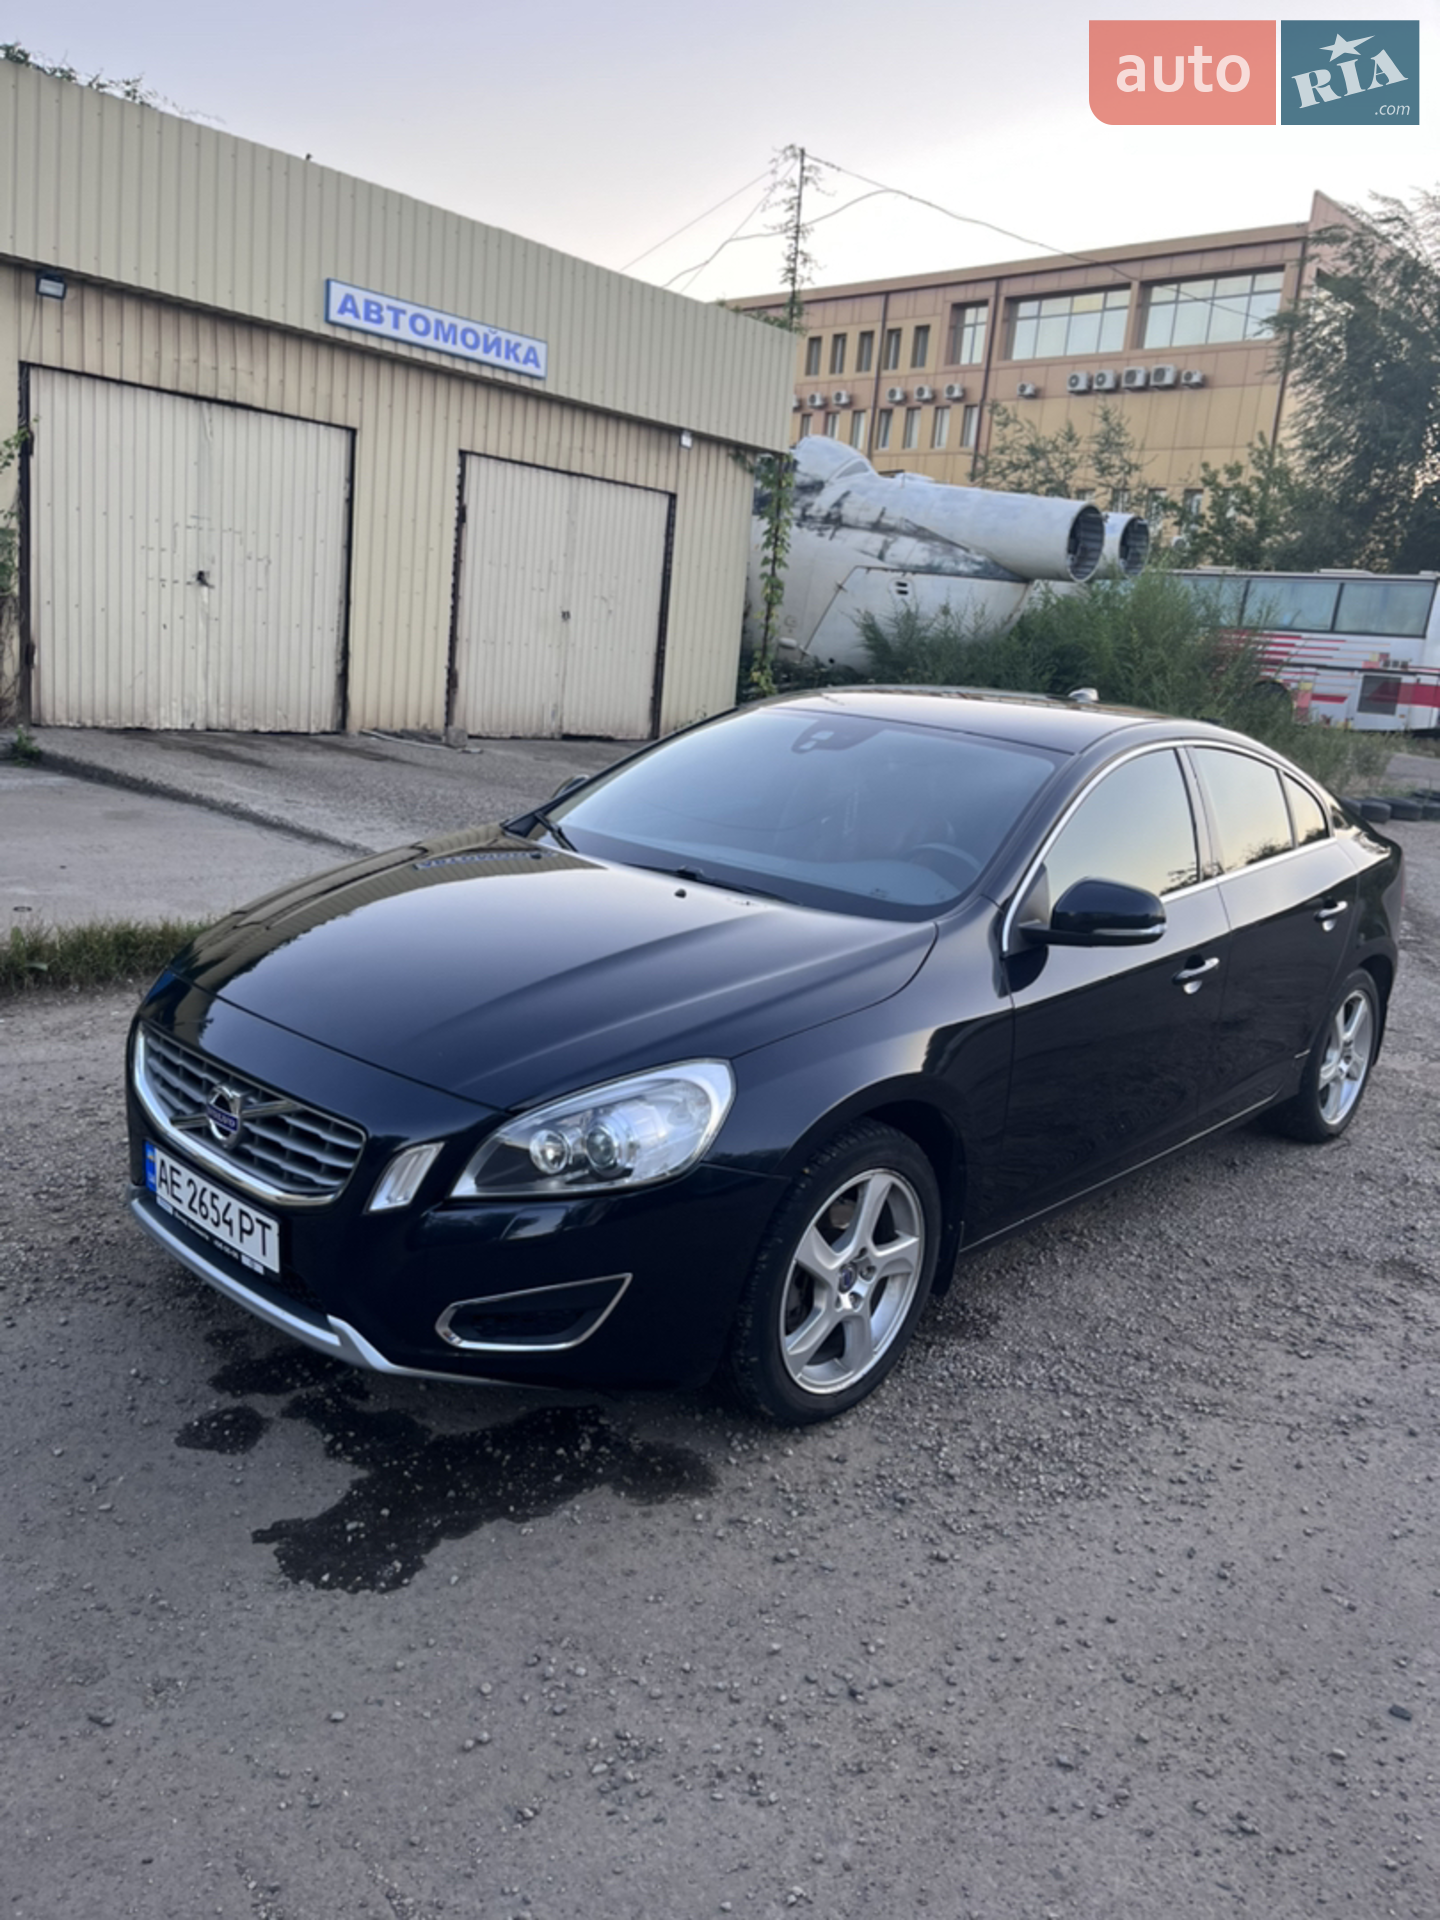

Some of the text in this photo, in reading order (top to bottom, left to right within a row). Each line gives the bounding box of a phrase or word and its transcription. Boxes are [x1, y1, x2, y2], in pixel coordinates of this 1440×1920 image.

[336, 292, 542, 369] АВТОМОЙКА
[207, 1106, 236, 1128] VOLVO
[158, 1158, 184, 1205] AE
[186, 1178, 234, 1238] 2654
[238, 1208, 273, 1257] PT
